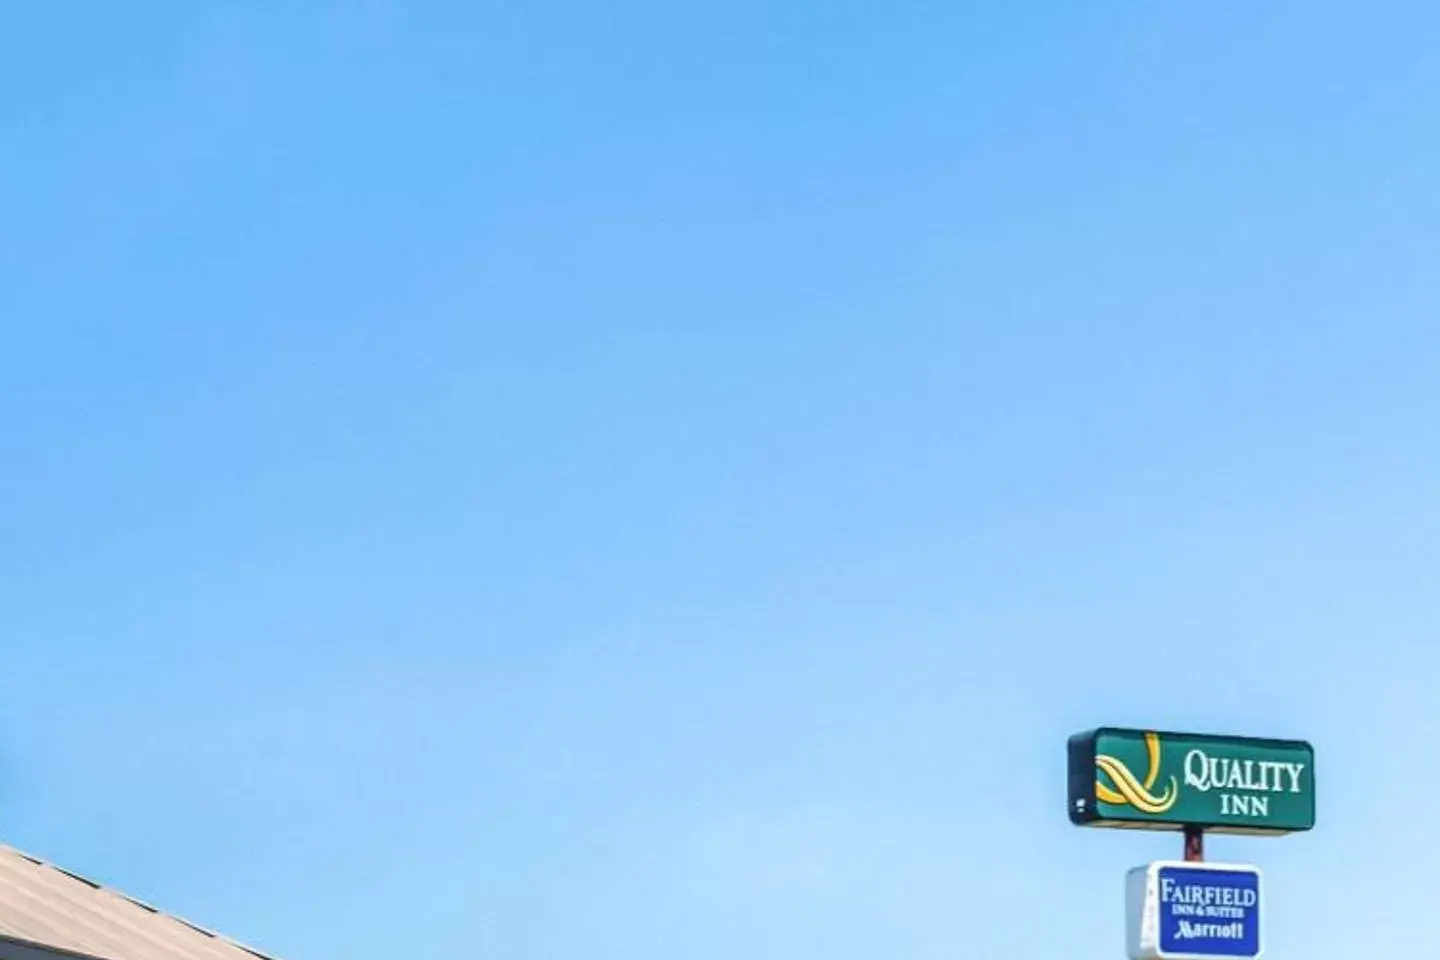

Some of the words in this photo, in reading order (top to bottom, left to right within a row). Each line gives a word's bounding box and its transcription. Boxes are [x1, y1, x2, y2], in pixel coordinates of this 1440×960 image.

[1184, 749, 1305, 792] QUALITY
[1220, 794, 1268, 816] INN
[1162, 878, 1257, 907] FAIRFIELD
[1174, 920, 1243, 939] Marriott
